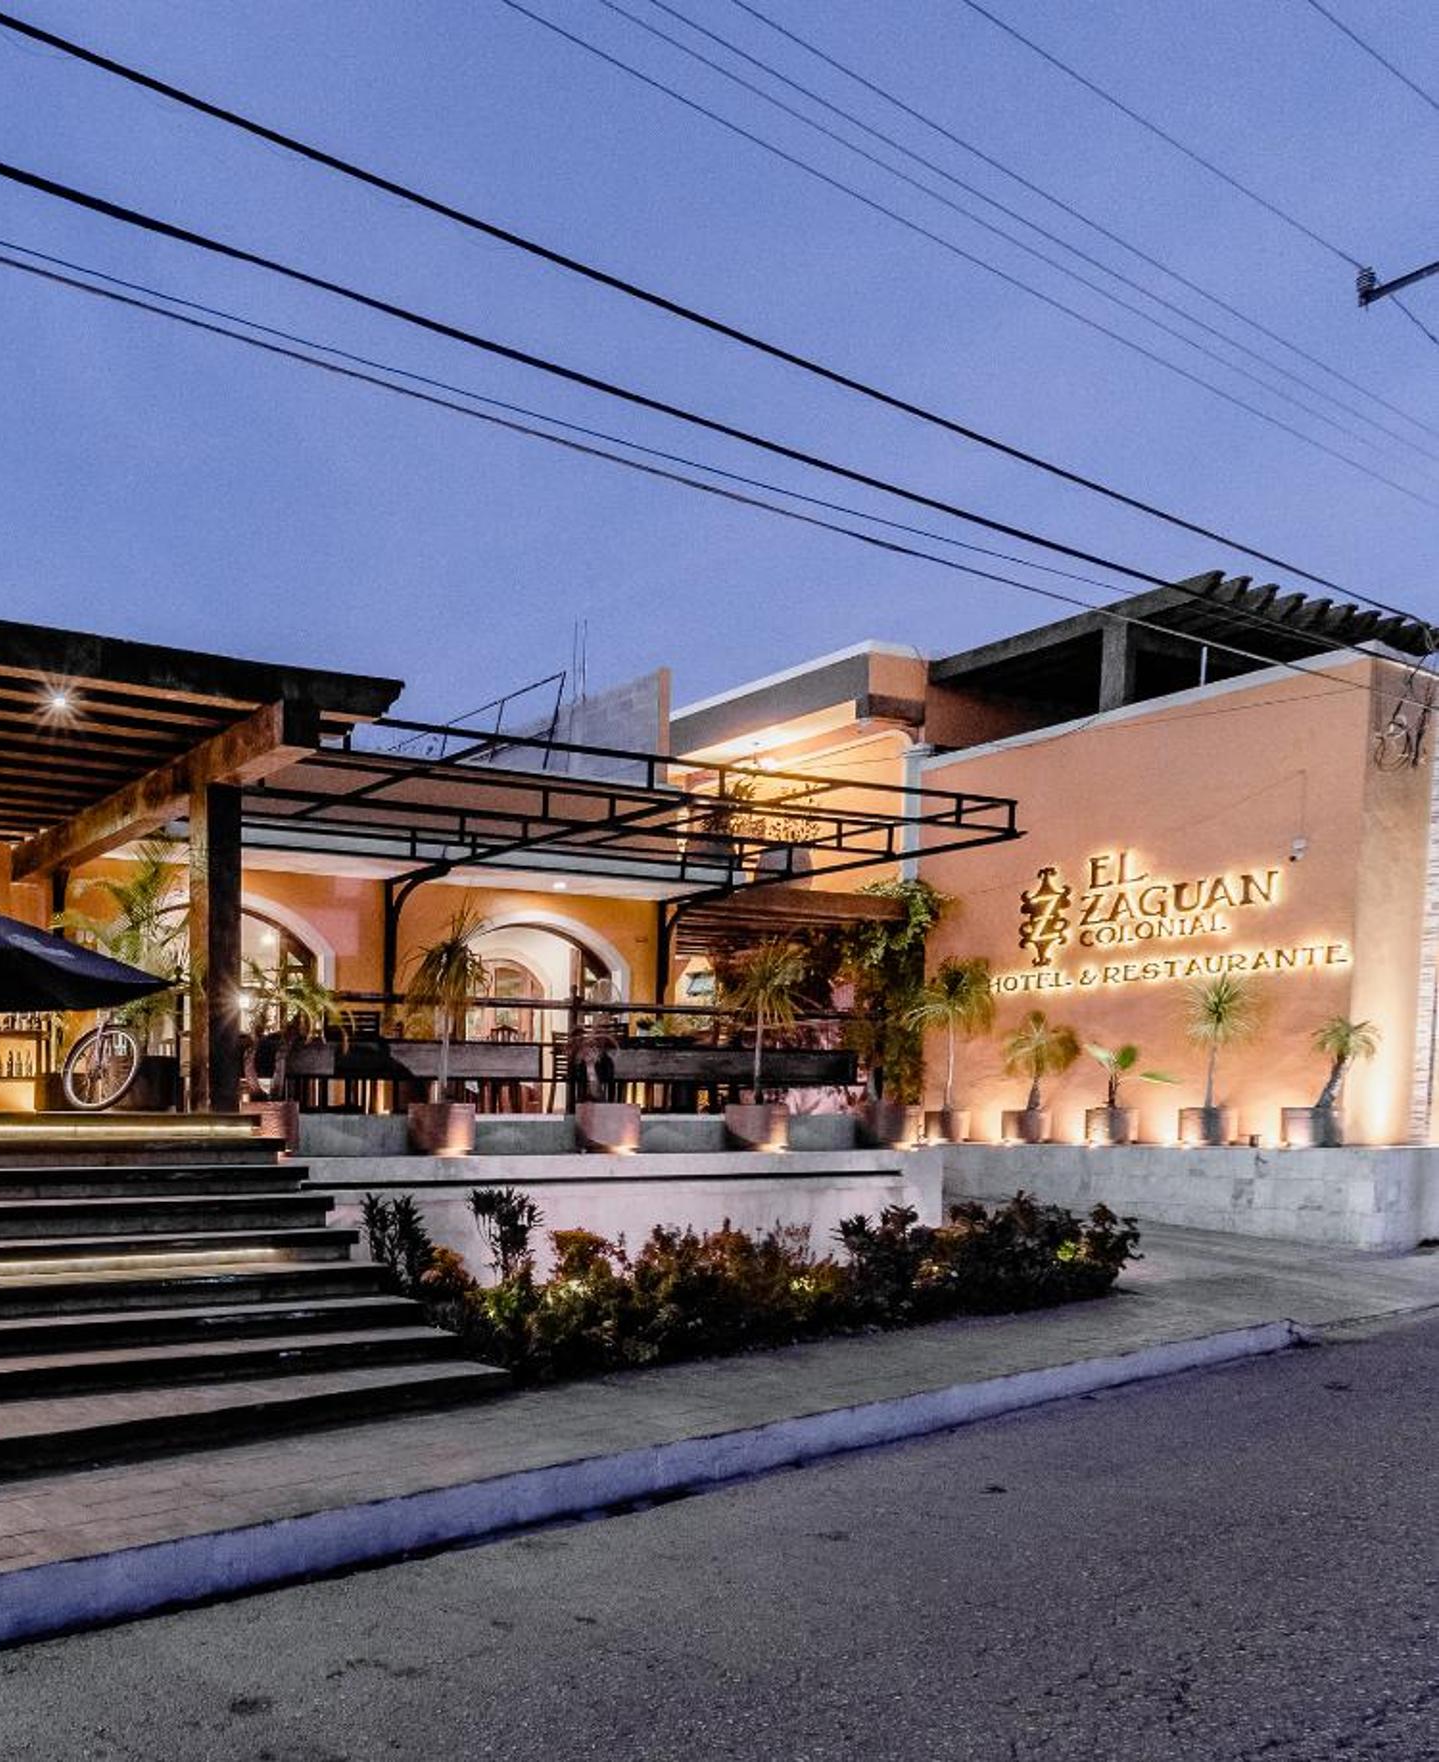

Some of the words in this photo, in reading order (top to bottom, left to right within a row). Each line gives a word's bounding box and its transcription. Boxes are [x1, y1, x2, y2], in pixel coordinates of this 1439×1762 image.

[1089, 853, 1149, 889] EL
[1078, 870, 1279, 926] ZAGUAN
[1079, 914, 1228, 947] COLONIAL
[988, 972, 1072, 993] HOTEL
[1080, 969, 1097, 985] &
[1103, 944, 1348, 984] RESTAURANTE
